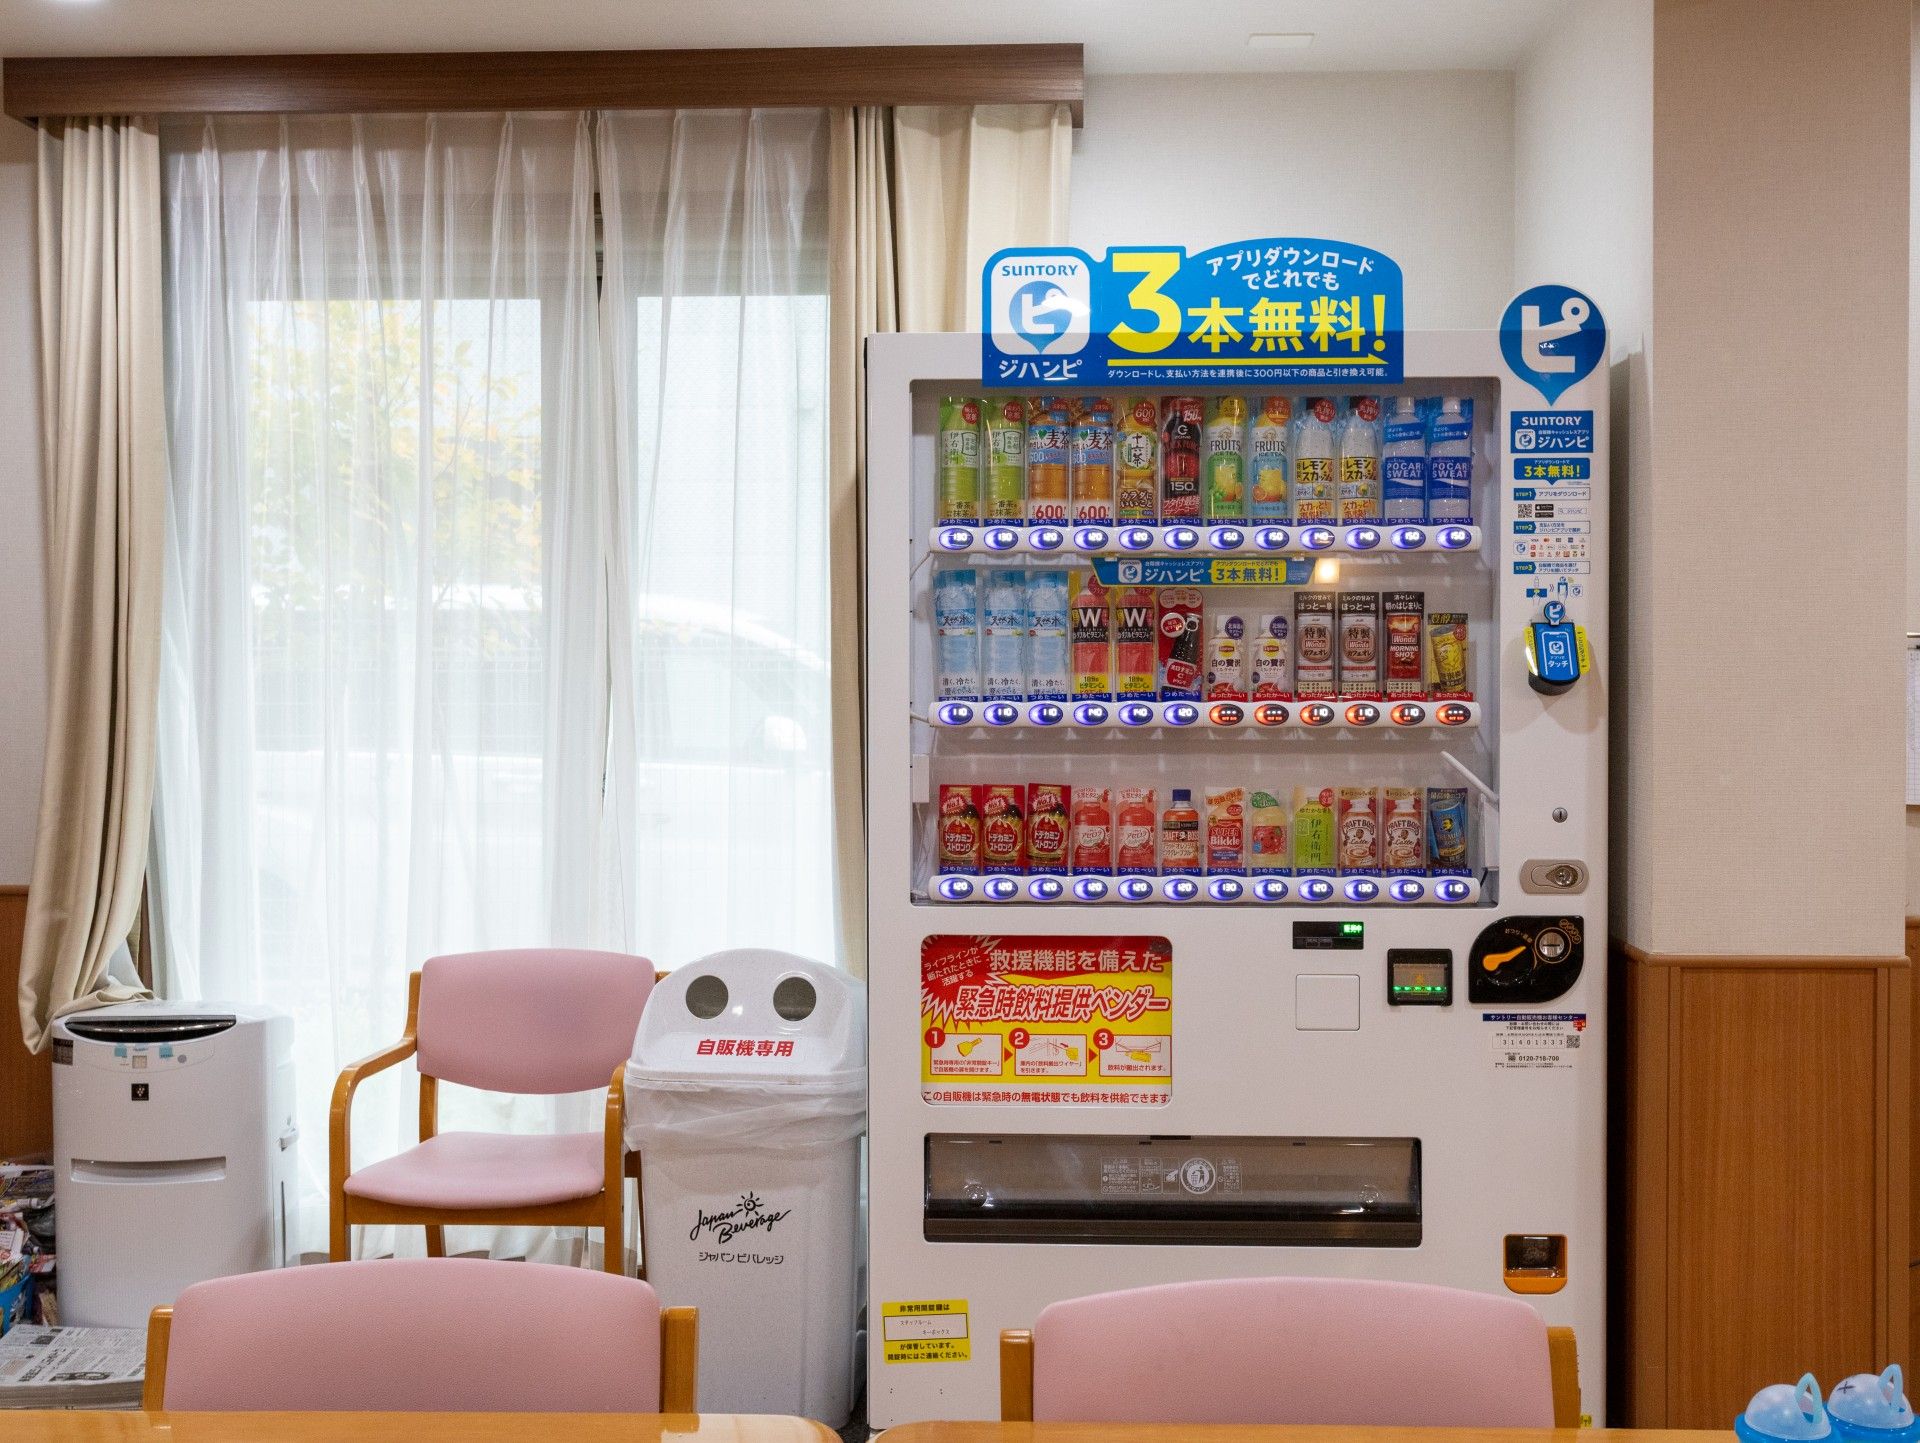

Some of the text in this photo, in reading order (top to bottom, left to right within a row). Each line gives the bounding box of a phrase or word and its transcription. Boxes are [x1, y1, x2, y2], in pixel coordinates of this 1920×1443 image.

[1206, 246, 1375, 276] アプリダウンロード
[1001, 264, 1078, 277] SUNTORY
[1242, 269, 1340, 291] でどれでも
[1521, 297, 1590, 373] ピ
[999, 360, 1083, 379] ジハンピ
[1521, 416, 1582, 426] SUNTORY
[1210, 440, 1241, 451] FRUITS
[1255, 441, 1285, 452] FRUITS
[1538, 436, 1590, 448] ジハンピ
[1131, 433, 1144, 467] 十六茶
[1303, 460, 1328, 470] レモン
[1346, 460, 1371, 469] レモン
[1303, 471, 1332, 481] スカッシュ
[1346, 470, 1376, 481] スカッシュ
[1387, 470, 1421, 478] SWEAT
[1432, 470, 1468, 478] SWEAT
[1524, 465, 1580, 477] 3本無料!
[1170, 482, 1194, 492] 150
[1121, 491, 1153, 500] カラダに
[1120, 500, 1153, 508] いいこと
[1144, 568, 1204, 582] ジハンピ
[1216, 568, 1279, 582] 3本無料!
[1298, 602, 1333, 611] ほっと一息
[1341, 602, 1376, 611] ほっと一息
[1079, 608, 1101, 627] W
[1124, 608, 1146, 627] W
[1304, 627, 1327, 639] 特製
[1348, 627, 1371, 639] 特製
[1395, 651, 1415, 659] SHOT
[953, 707, 968, 716] 110
[998, 707, 1012, 716] 110
[1043, 708, 1057, 717] 110
[1314, 708, 1328, 717] 110
[1359, 708, 1374, 717] 110
[1405, 708, 1419, 717] 110
[1211, 828, 1239, 837] SUPER
[1035, 840, 1059, 849] ストロング
[1210, 836, 1240, 846] Bikkle
[946, 842, 971, 852] ストロング
[989, 842, 1013, 852] ストロング
[1449, 883, 1463, 893] 110
[923, 946, 979, 971] ライフラインが
[989, 949, 1164, 972] 救援機能を備えた
[927, 956, 982, 981] 断たれたときに
[942, 969, 974, 987] 活躍する
[954, 986, 1169, 1021] 緊急時飲料提供ベンダー
[931, 1031, 938, 1045] 1
[1014, 1031, 1024, 1045] 2
[1099, 1032, 1109, 1046] 3
[696, 1039, 795, 1057] 自販機専用
[923, 1091, 1169, 1104] この自販機は緊急時の無電状態でも飲料を供給できます
[690, 1208, 743, 1241] Japan
[712, 1209, 792, 1244] Beverage
[699, 1251, 784, 1265] ジャパン ビバレッジ
